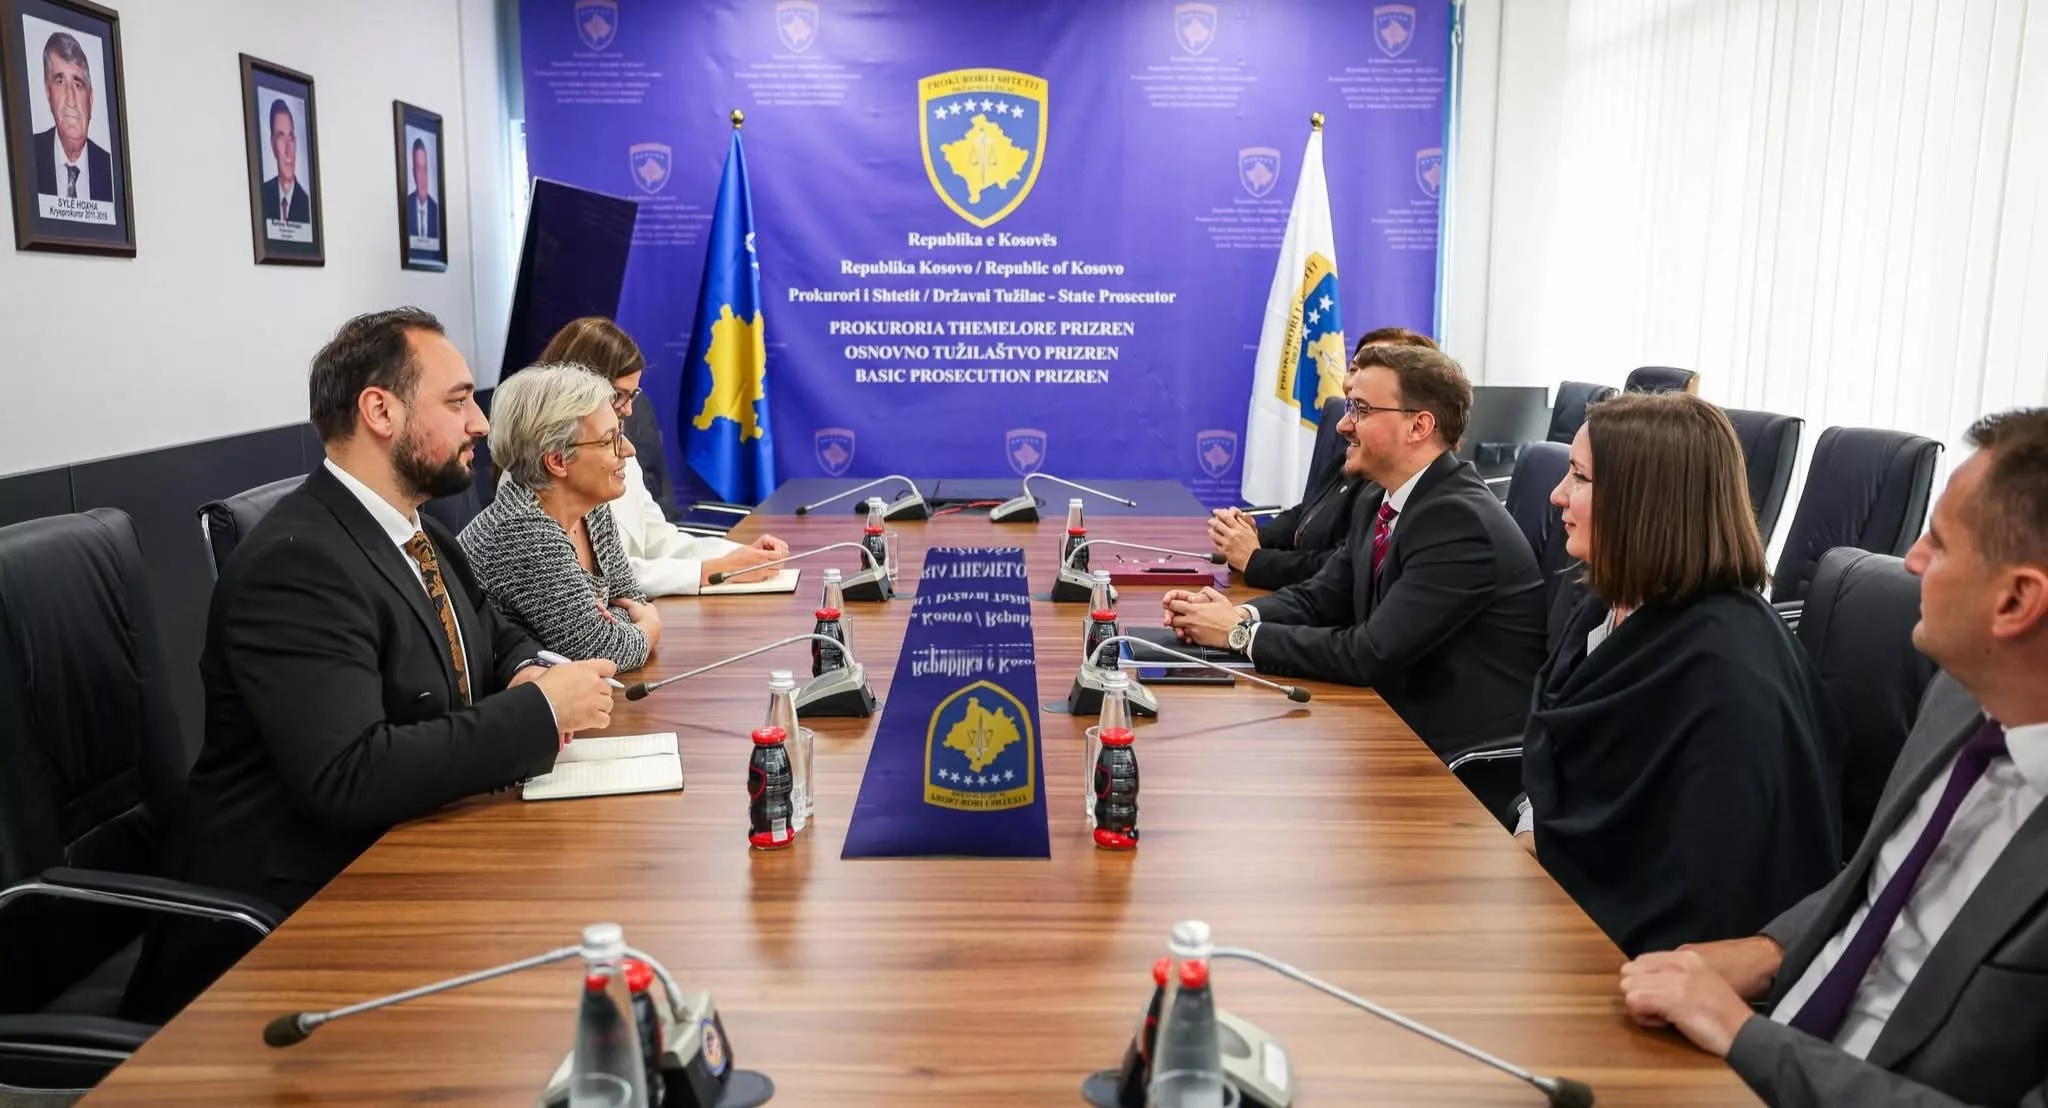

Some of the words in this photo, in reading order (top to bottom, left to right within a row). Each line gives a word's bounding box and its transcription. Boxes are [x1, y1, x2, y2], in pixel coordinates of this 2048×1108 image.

[908, 232, 984, 250] Republika
[986, 236, 996, 247] e
[998, 232, 1058, 247] Kosovës
[840, 260, 916, 278] Republika
[919, 260, 973, 275] Kosovo
[975, 260, 983, 275] /
[985, 260, 1050, 278] Republic
[1052, 260, 1069, 275] of
[1070, 261, 1125, 275] Kosovo
[788, 287, 861, 302] Prokurori
[863, 288, 870, 302] i
[872, 287, 921, 303] Shtetit
[923, 288, 930, 303] /
[932, 288, 991, 303] Državni
[993, 288, 1046, 303] Tužilac
[1057, 288, 1096, 304] State
[1098, 288, 1177, 304] Prosecutor
[829, 320, 945, 336] PROKURORIA
[947, 320, 1057, 336] THEMELORE
[1060, 321, 1135, 337] PRIZREN
[844, 345, 930, 360] OSNOVNO
[932, 342, 1042, 360] TUŽILAŠTVO
[1044, 345, 1119, 361] PRIZREN
[855, 368, 907, 383] BASIC
[909, 368, 1031, 384] PROSECUTION
[1034, 368, 1109, 384] PRIZREN
